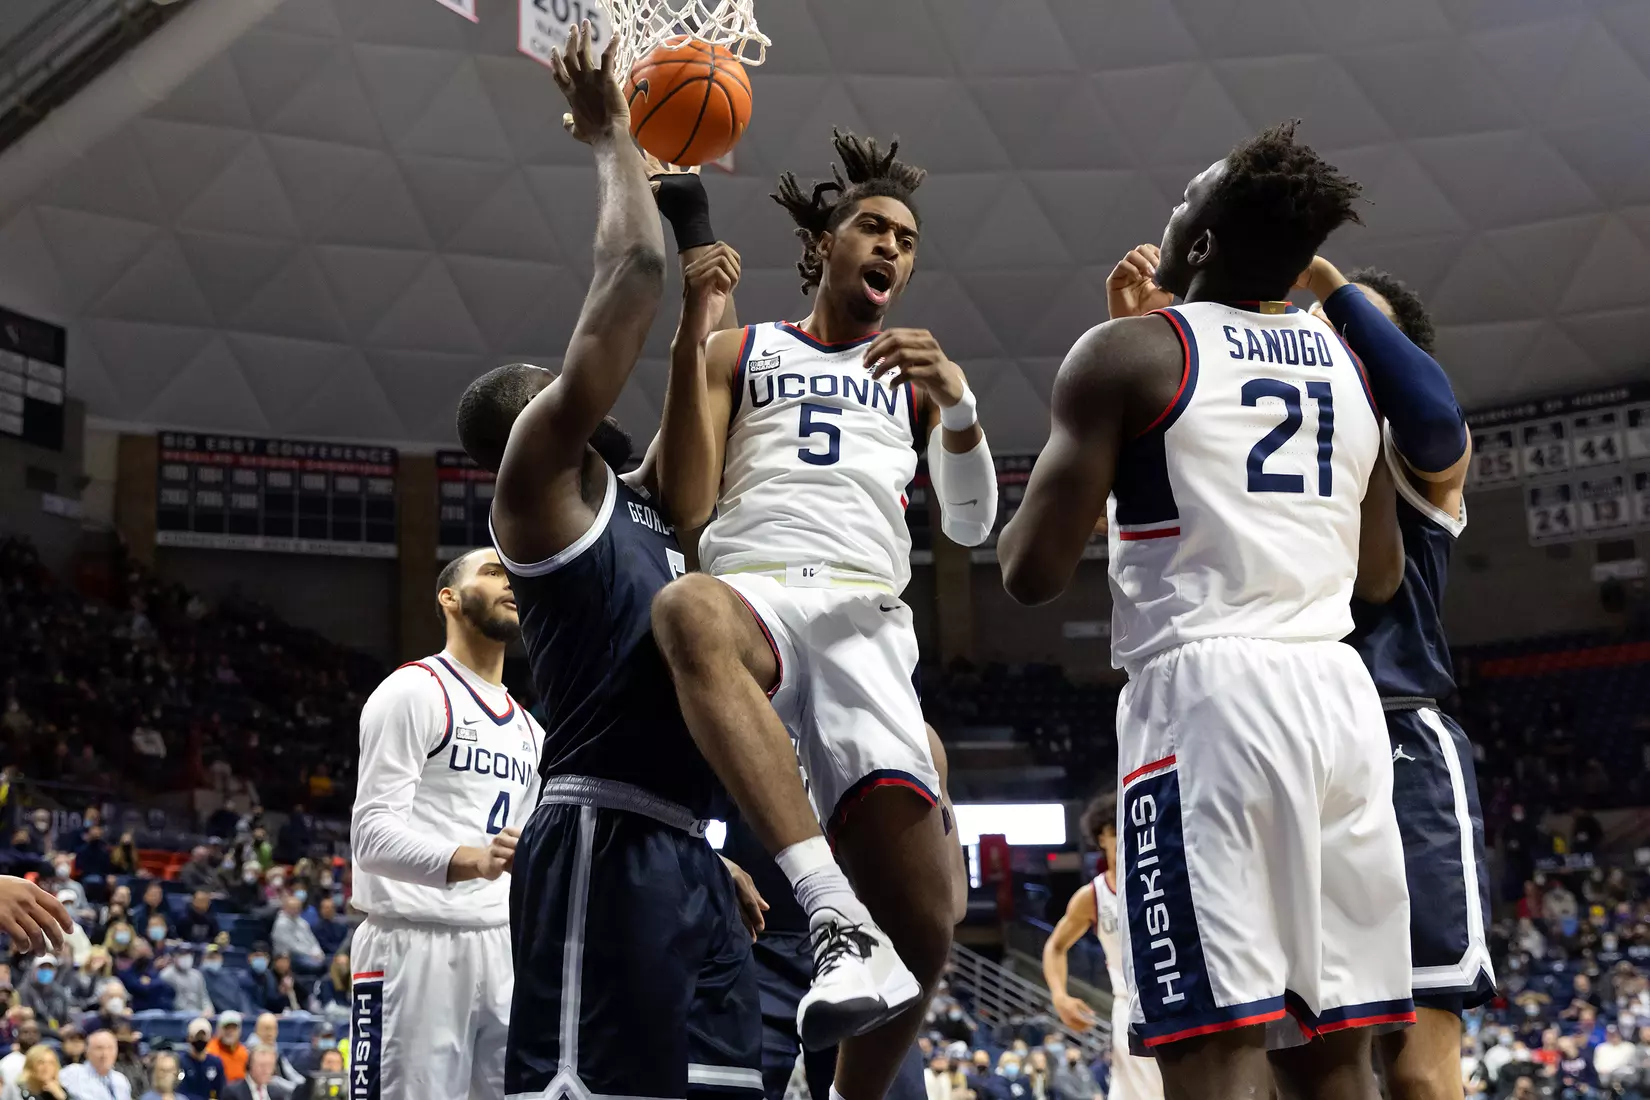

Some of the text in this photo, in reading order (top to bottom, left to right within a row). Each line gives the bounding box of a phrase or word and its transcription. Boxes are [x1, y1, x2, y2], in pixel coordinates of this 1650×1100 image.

[1222, 325, 1334, 368] SANOGO
[748, 373, 900, 417] UCONN
[797, 402, 843, 466] 5
[1240, 377, 1335, 497] 21
[1131, 793, 1186, 1005] HUSKIES
[354, 993, 372, 1100] HUSKI
